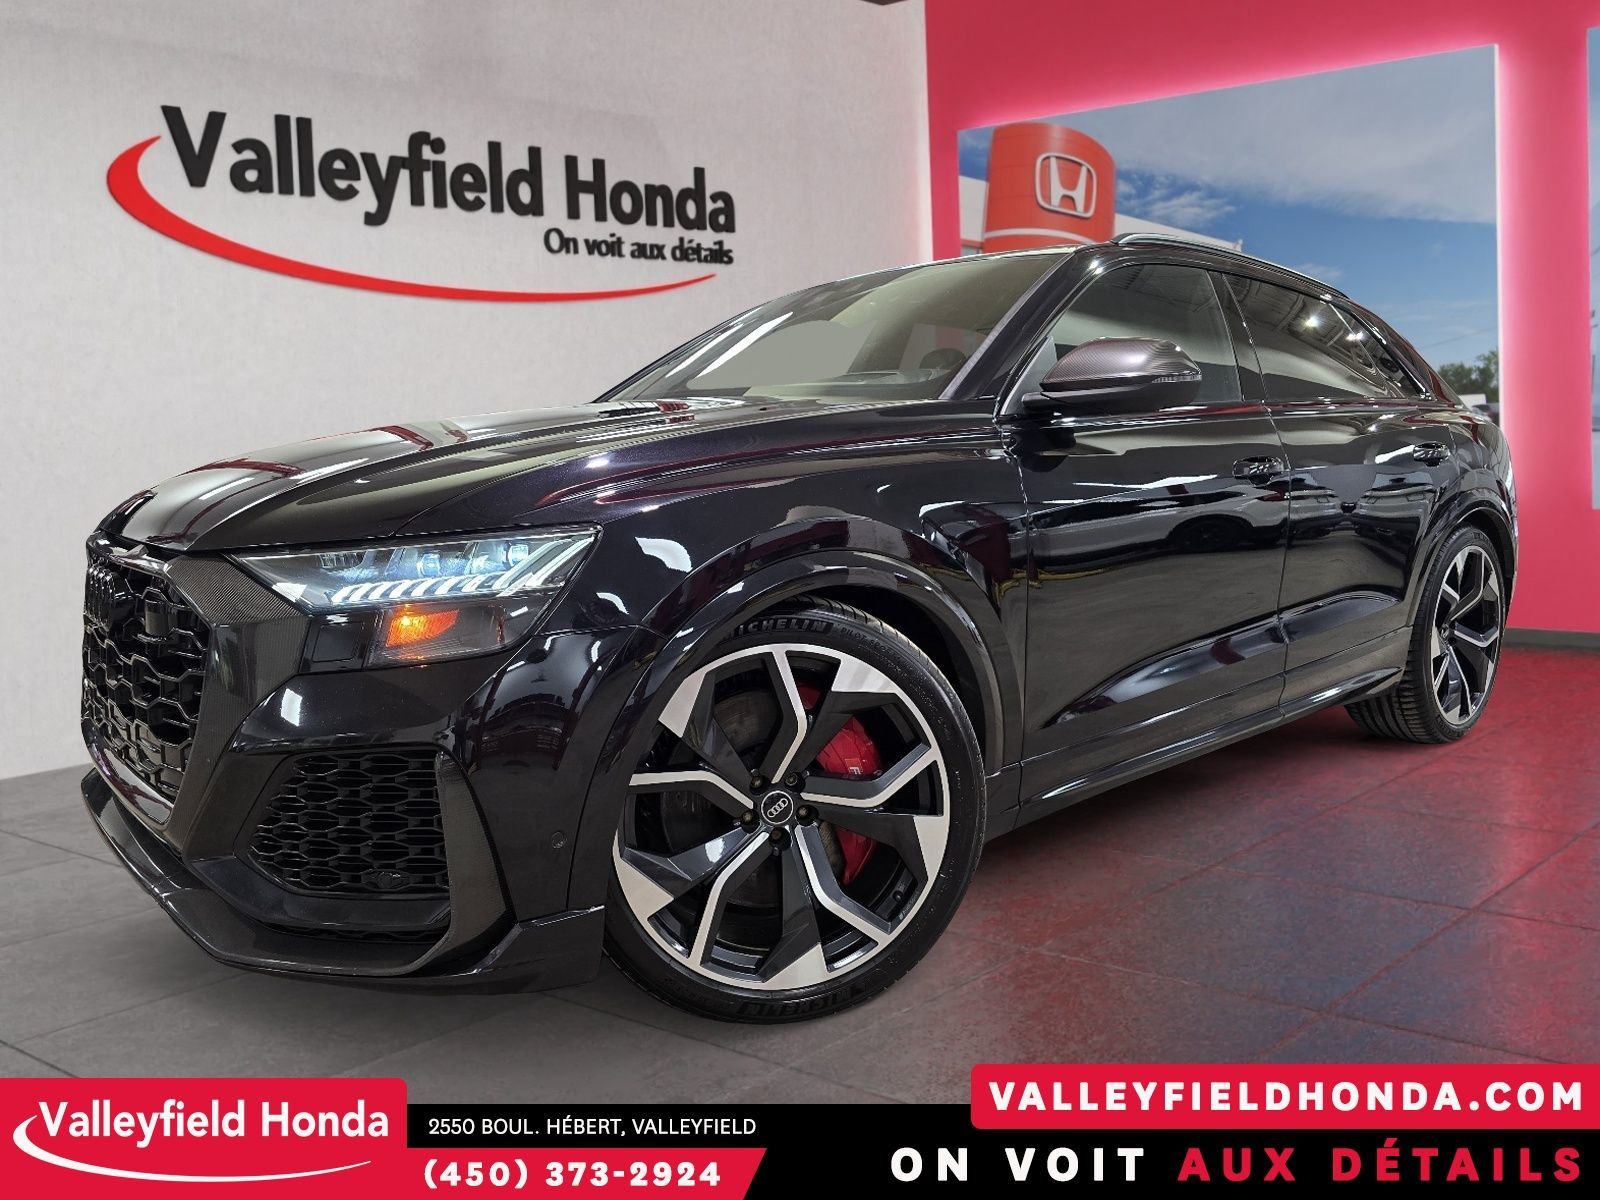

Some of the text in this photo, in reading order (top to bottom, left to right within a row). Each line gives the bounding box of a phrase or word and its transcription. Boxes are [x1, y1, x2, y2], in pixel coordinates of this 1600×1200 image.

[160, 104, 736, 233] Valleyfield Honda
[543, 227, 734, 265] On voit aux détails
